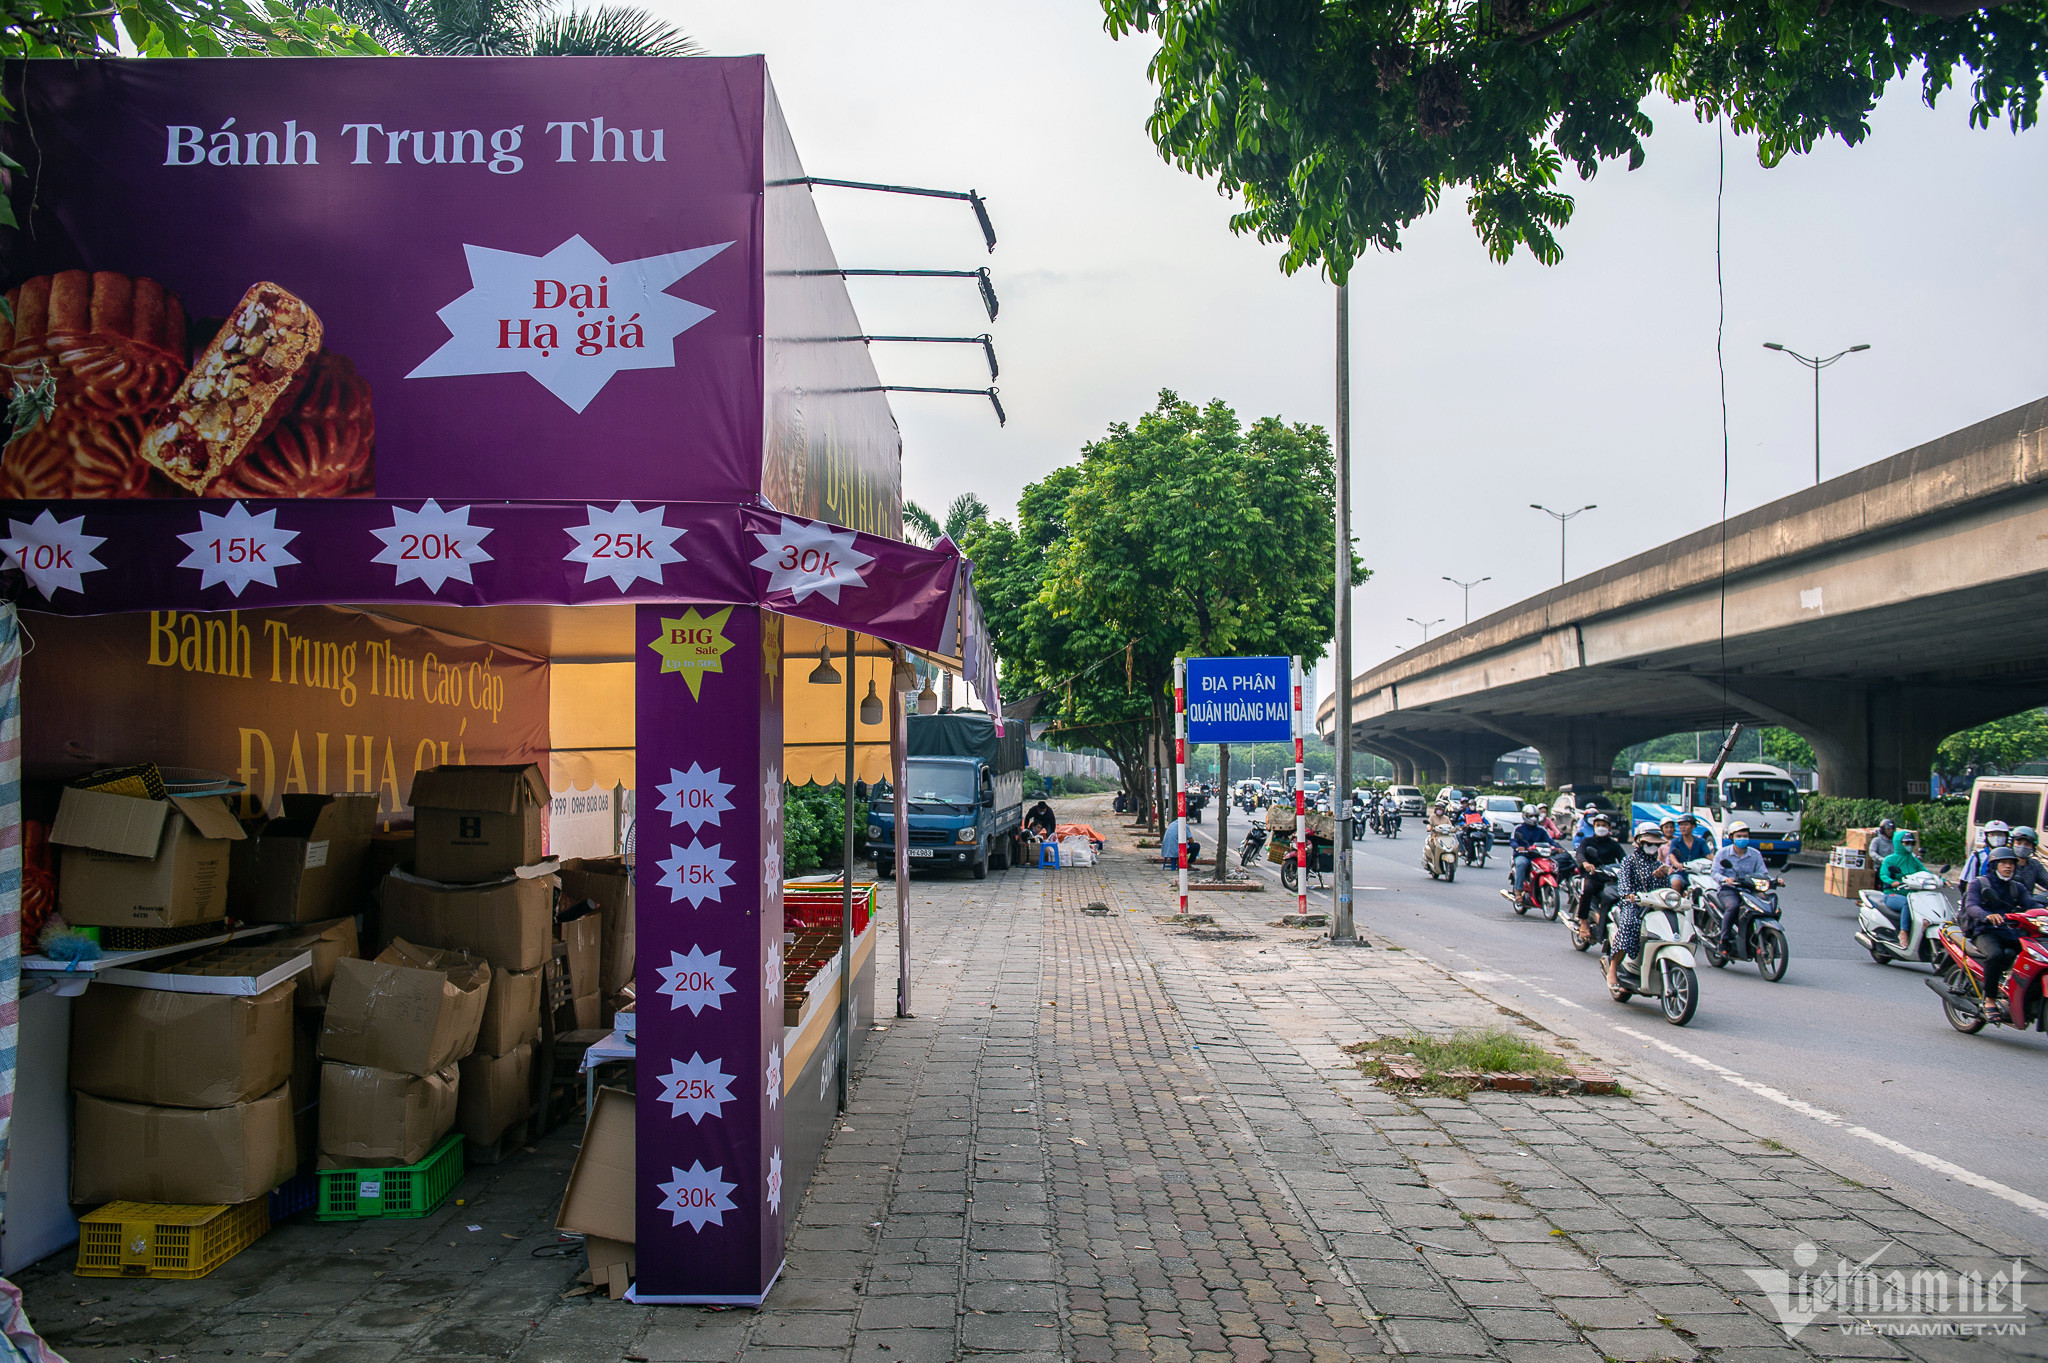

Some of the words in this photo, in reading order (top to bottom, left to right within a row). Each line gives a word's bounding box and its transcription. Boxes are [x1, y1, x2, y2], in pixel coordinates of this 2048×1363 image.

[163, 117, 319, 166] Bánh
[340, 123, 524, 175] Trung
[545, 116, 667, 163] Thu
[533, 276, 609, 315] Đại
[497, 319, 559, 358] Hạ
[576, 311, 645, 357] giá
[209, 537, 267, 564] 15k
[400, 533, 462, 560] 20k
[592, 533, 654, 559] 25k
[16, 544, 73, 571] 10k
[778, 545, 840, 579] 30k
[670, 628, 713, 645] BIG
[695, 646, 719, 655] Sale
[264, 620, 357, 708] Trung
[365, 639, 415, 701] Thu
[422, 652, 462, 707] Cao
[469, 650, 504, 724] Cấp
[666, 659, 681, 669] Up
[697, 659, 717, 668] 50%
[1201, 676, 1228, 693] ĐỊA
[1233, 673, 1276, 693] PHẬN
[1190, 700, 1222, 725] QUẬN
[1224, 698, 1264, 721] HOÀNG
[1266, 702, 1288, 721] MAI
[555, 798, 566, 816] 999
[572, 797, 585, 814] 0969
[599, 795, 609, 811] 068
[676, 789, 715, 808] 10k
[767, 788, 777, 806] 10k
[676, 864, 715, 884] 15k
[768, 860, 777, 880] 15k
[675, 971, 716, 992] 20k
[675, 1079, 715, 1100] 25k
[677, 1188, 717, 1208] 30k
